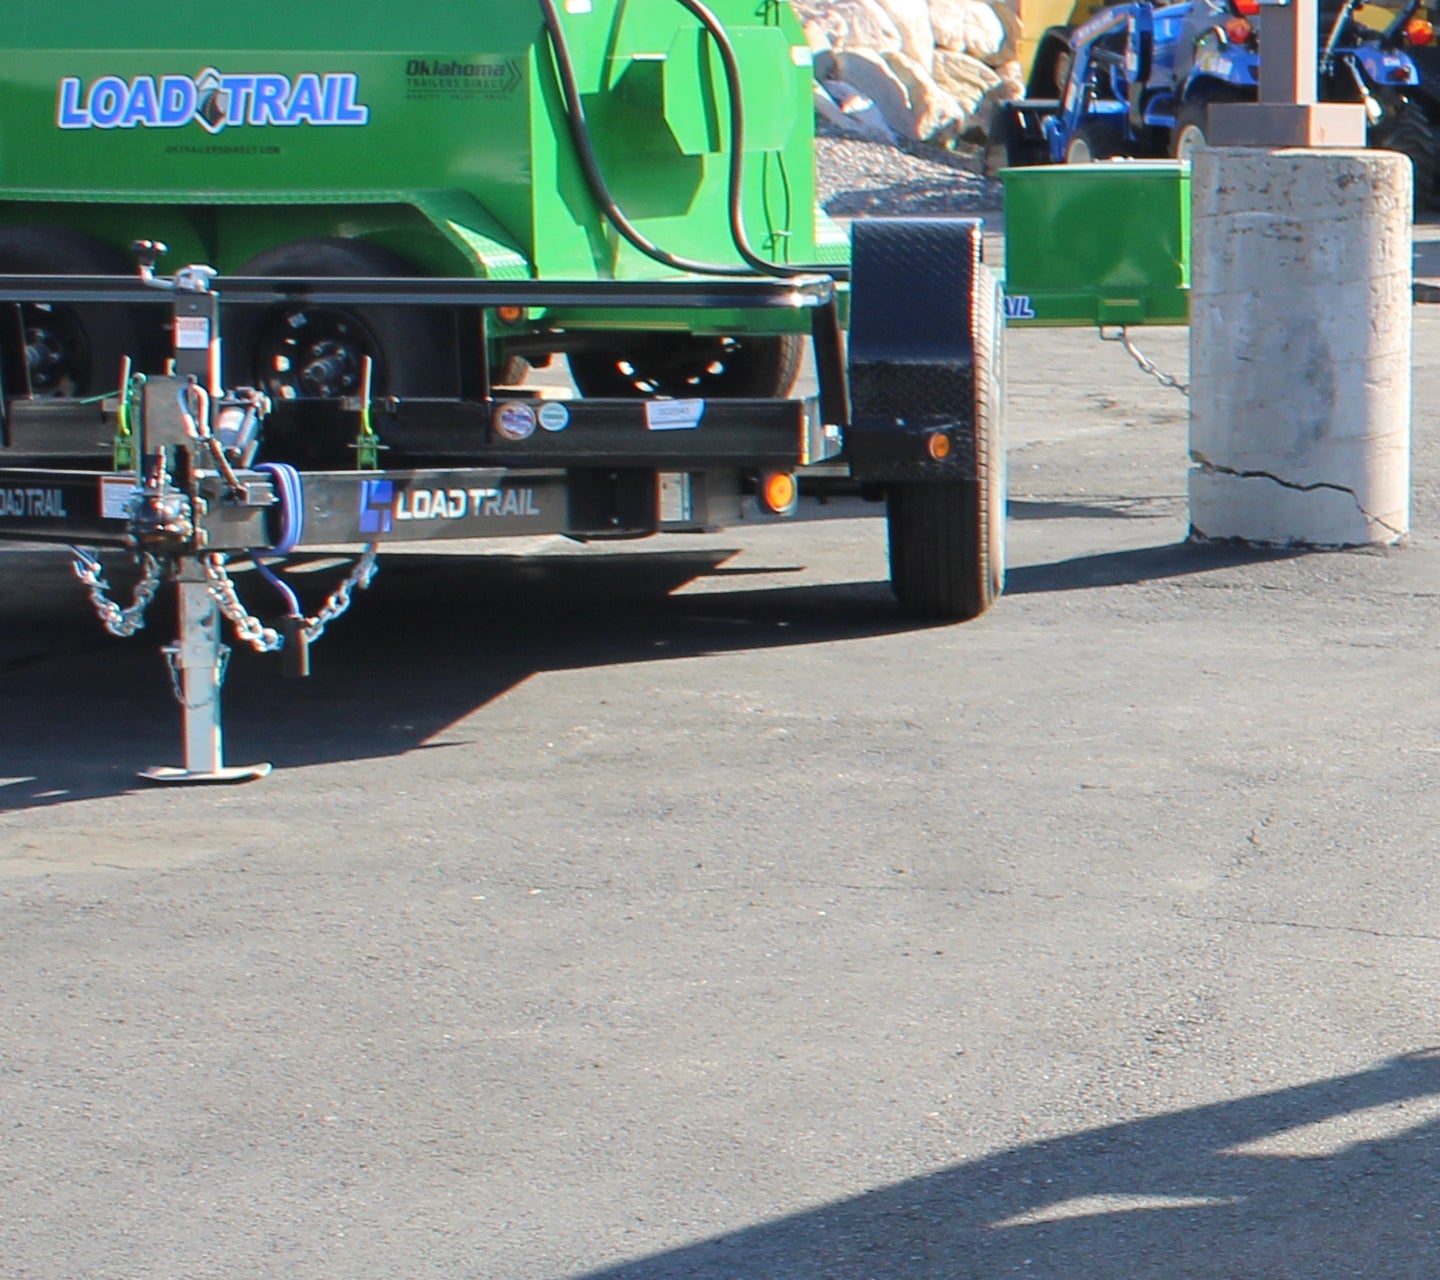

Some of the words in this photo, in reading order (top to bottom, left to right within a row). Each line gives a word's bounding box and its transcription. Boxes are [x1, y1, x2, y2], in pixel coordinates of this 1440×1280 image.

[405, 59, 506, 77] Oklahoma
[57, 75, 198, 129] LOAD
[220, 72, 369, 127] TRAIL
[0, 488, 25, 517] OAD
[25, 488, 68, 518] TRAIL
[396, 488, 466, 520] LOAD
[467, 487, 541, 517] TRAIL
